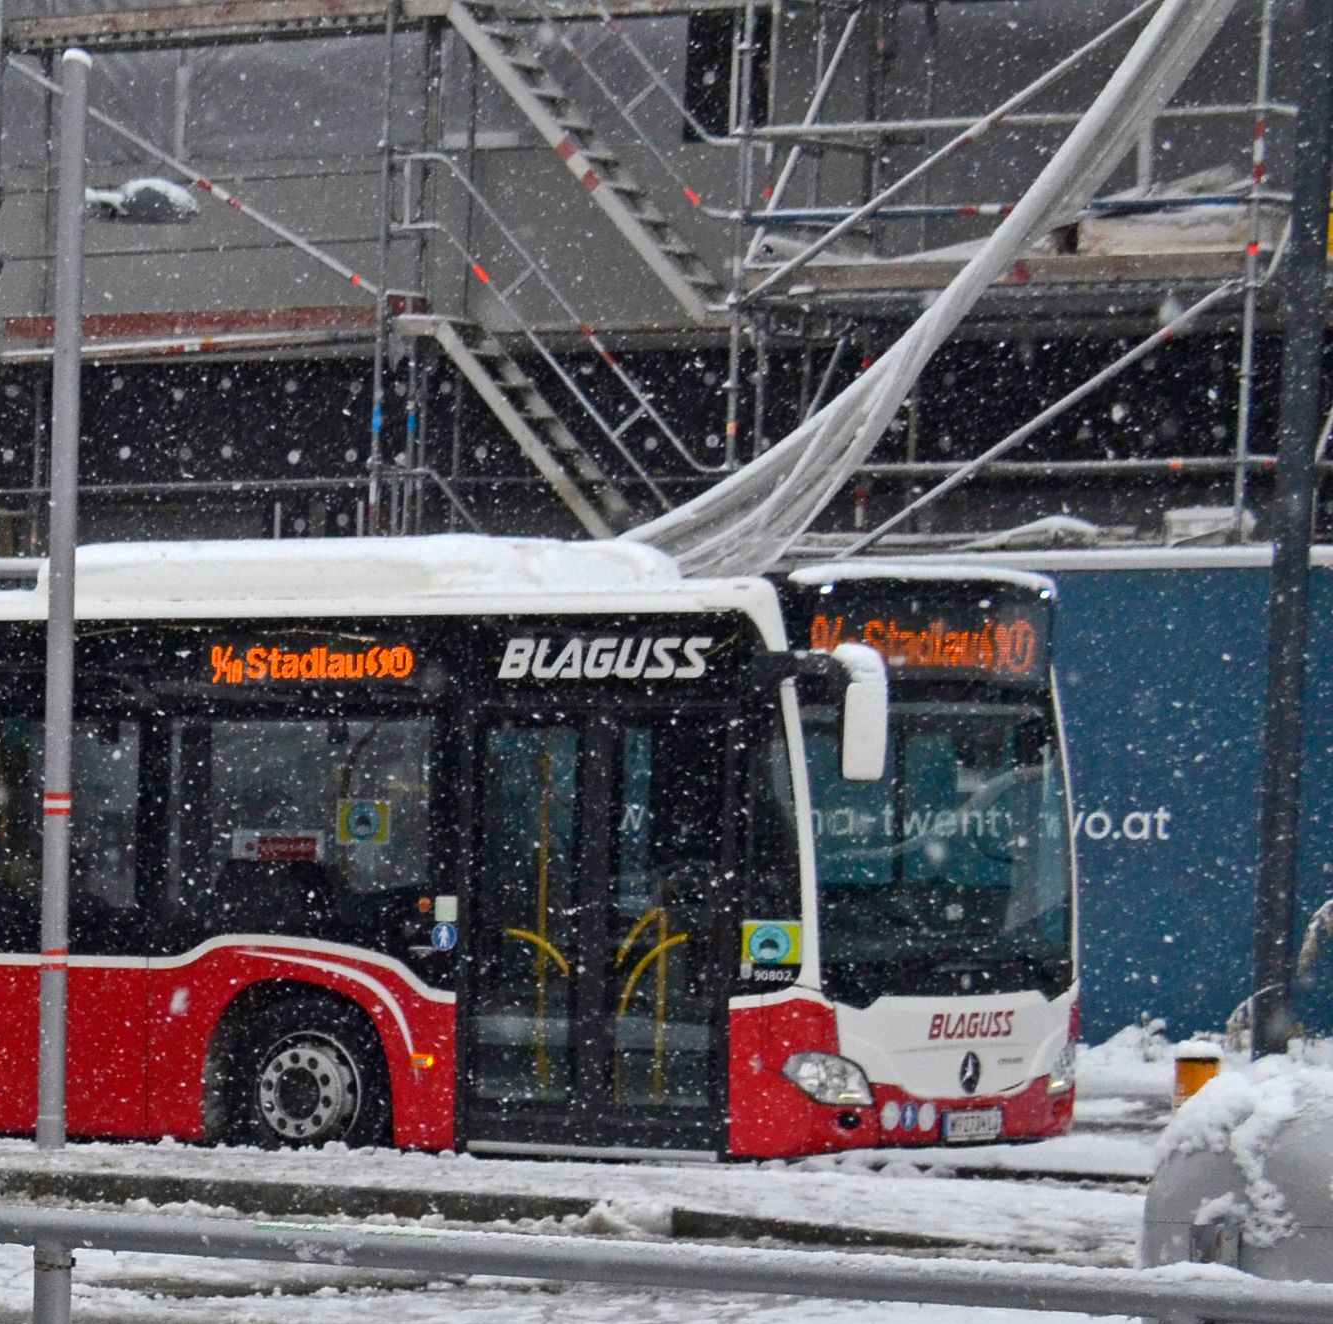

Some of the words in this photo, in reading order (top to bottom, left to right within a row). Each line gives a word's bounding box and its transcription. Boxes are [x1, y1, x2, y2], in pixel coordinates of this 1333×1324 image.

[246, 645, 365, 680] Stadlau
[497, 637, 714, 679] BLAGUSS
[754, 969, 793, 982] 90802
[927, 1009, 1016, 1040] BLAGUSS
